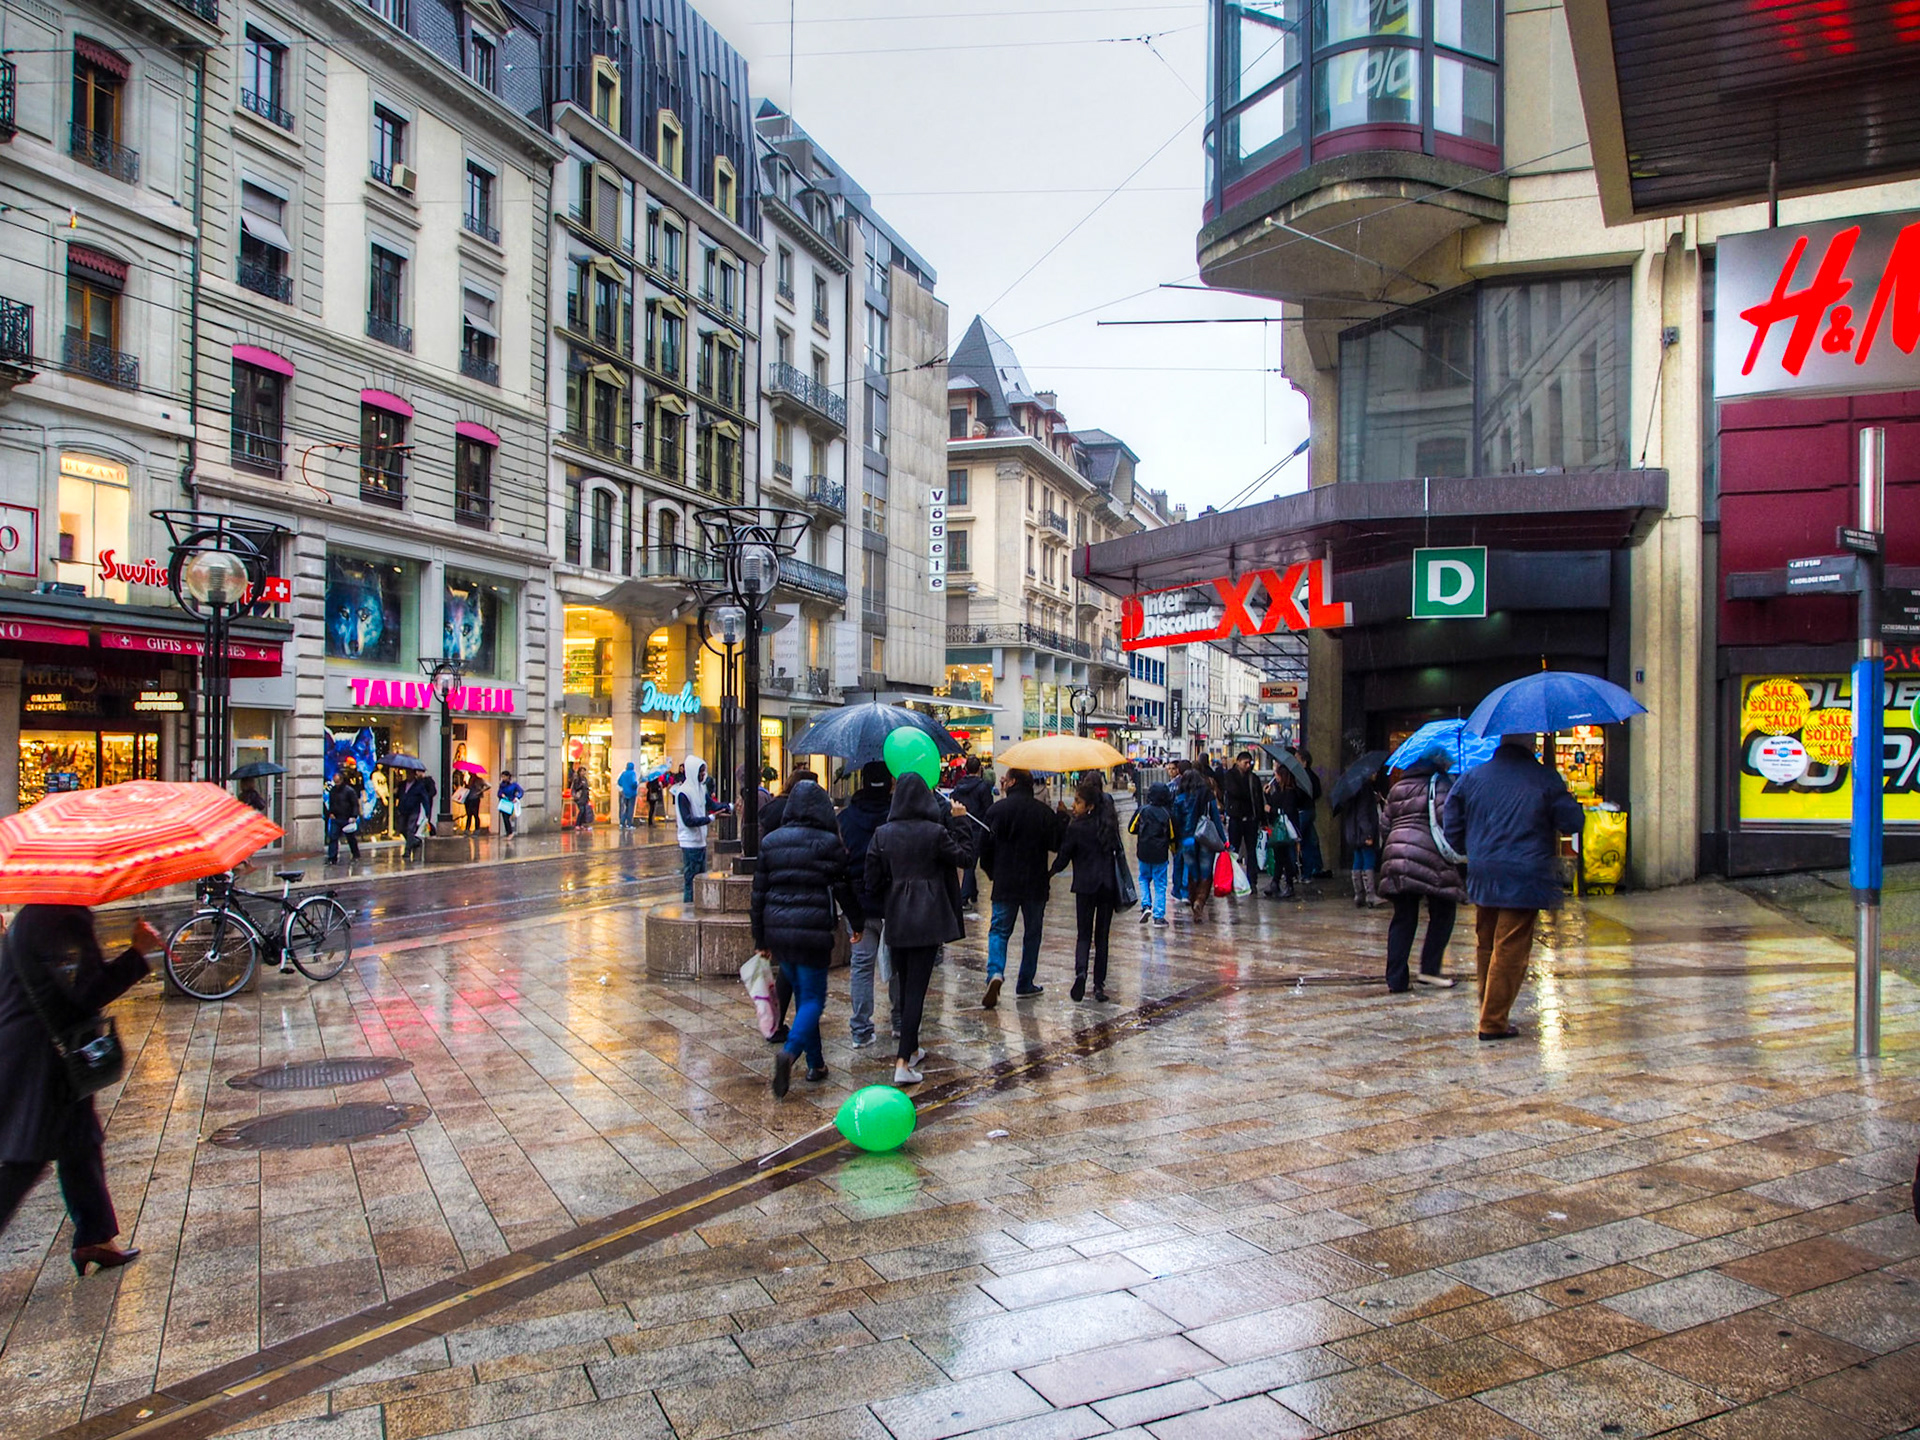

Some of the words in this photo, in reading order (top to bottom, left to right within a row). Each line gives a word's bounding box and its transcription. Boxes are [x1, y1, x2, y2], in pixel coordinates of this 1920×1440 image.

[1428, 560, 1475, 606] D
[1143, 594, 1184, 615] Inter
[1213, 559, 1351, 639] XXL
[1144, 607, 1217, 638] Discount
[146, 638, 182, 651] GIFTS
[351, 678, 434, 709] TALLY
[1763, 684, 1795, 696] SALE
[140, 692, 178, 701] MOLARD
[640, 680, 701, 723] Douglas
[134, 702, 184, 711] SOUVENIRS
[1750, 700, 1800, 712] SOLDES
[1765, 715, 1801, 727] SALDI
[1819, 714, 1851, 726] SALE
